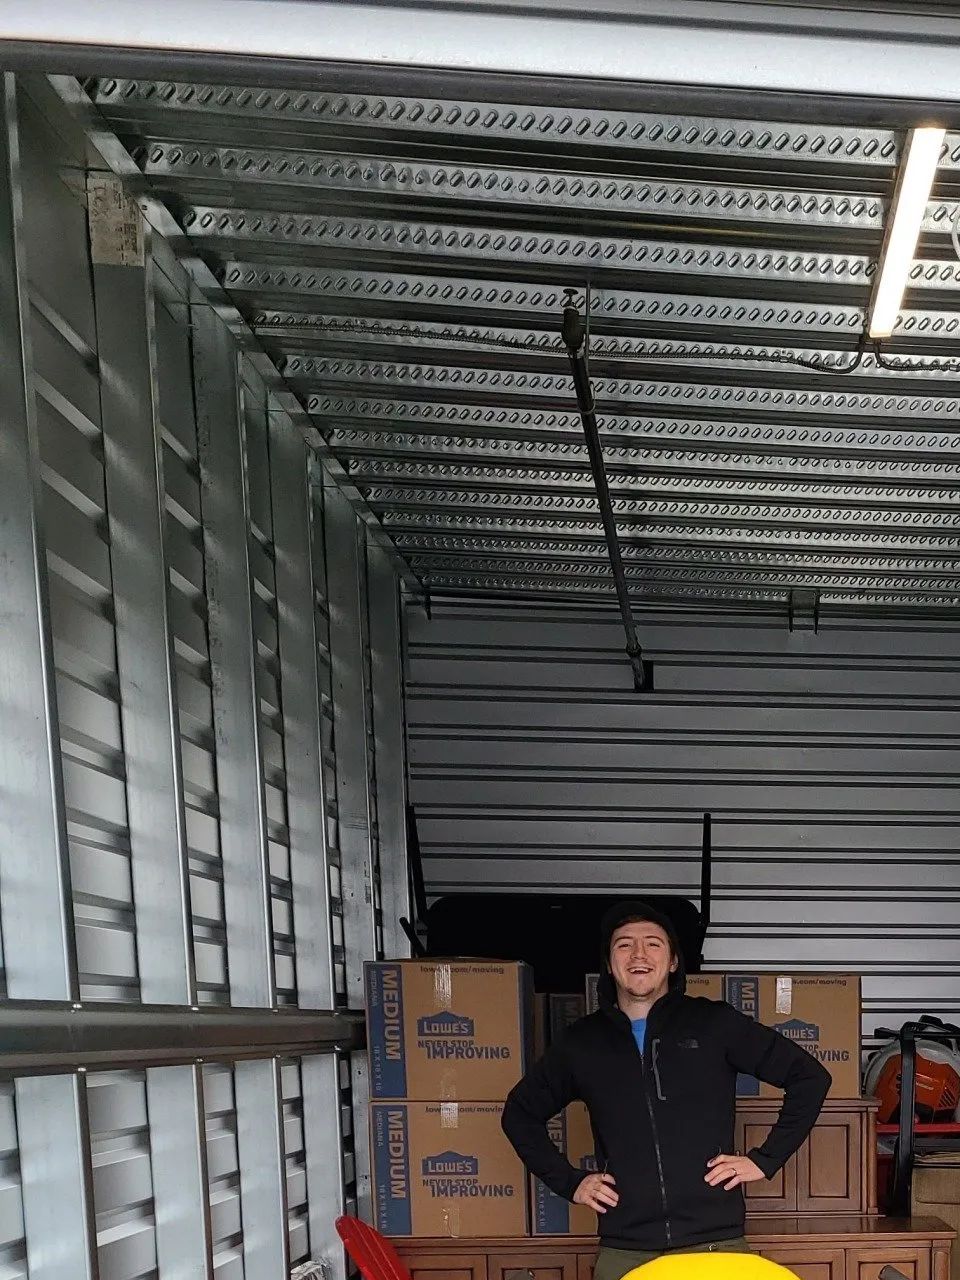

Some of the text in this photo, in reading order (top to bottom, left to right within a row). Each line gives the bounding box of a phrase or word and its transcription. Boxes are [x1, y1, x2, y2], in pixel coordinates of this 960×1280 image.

[381, 969, 401, 1060] MEDIUM
[423, 1020, 470, 1034] LOWE'S
[779, 1027, 814, 1039] OWE'S
[417, 1040, 474, 1049] NEVER STOP
[427, 1046, 511, 1059] IMPROVING
[388, 1111, 406, 1199] MEDIUM
[428, 1160, 472, 1173] LOWE'S
[422, 1179, 478, 1187] NEVER STOP
[431, 1185, 514, 1198] IMPROVING
